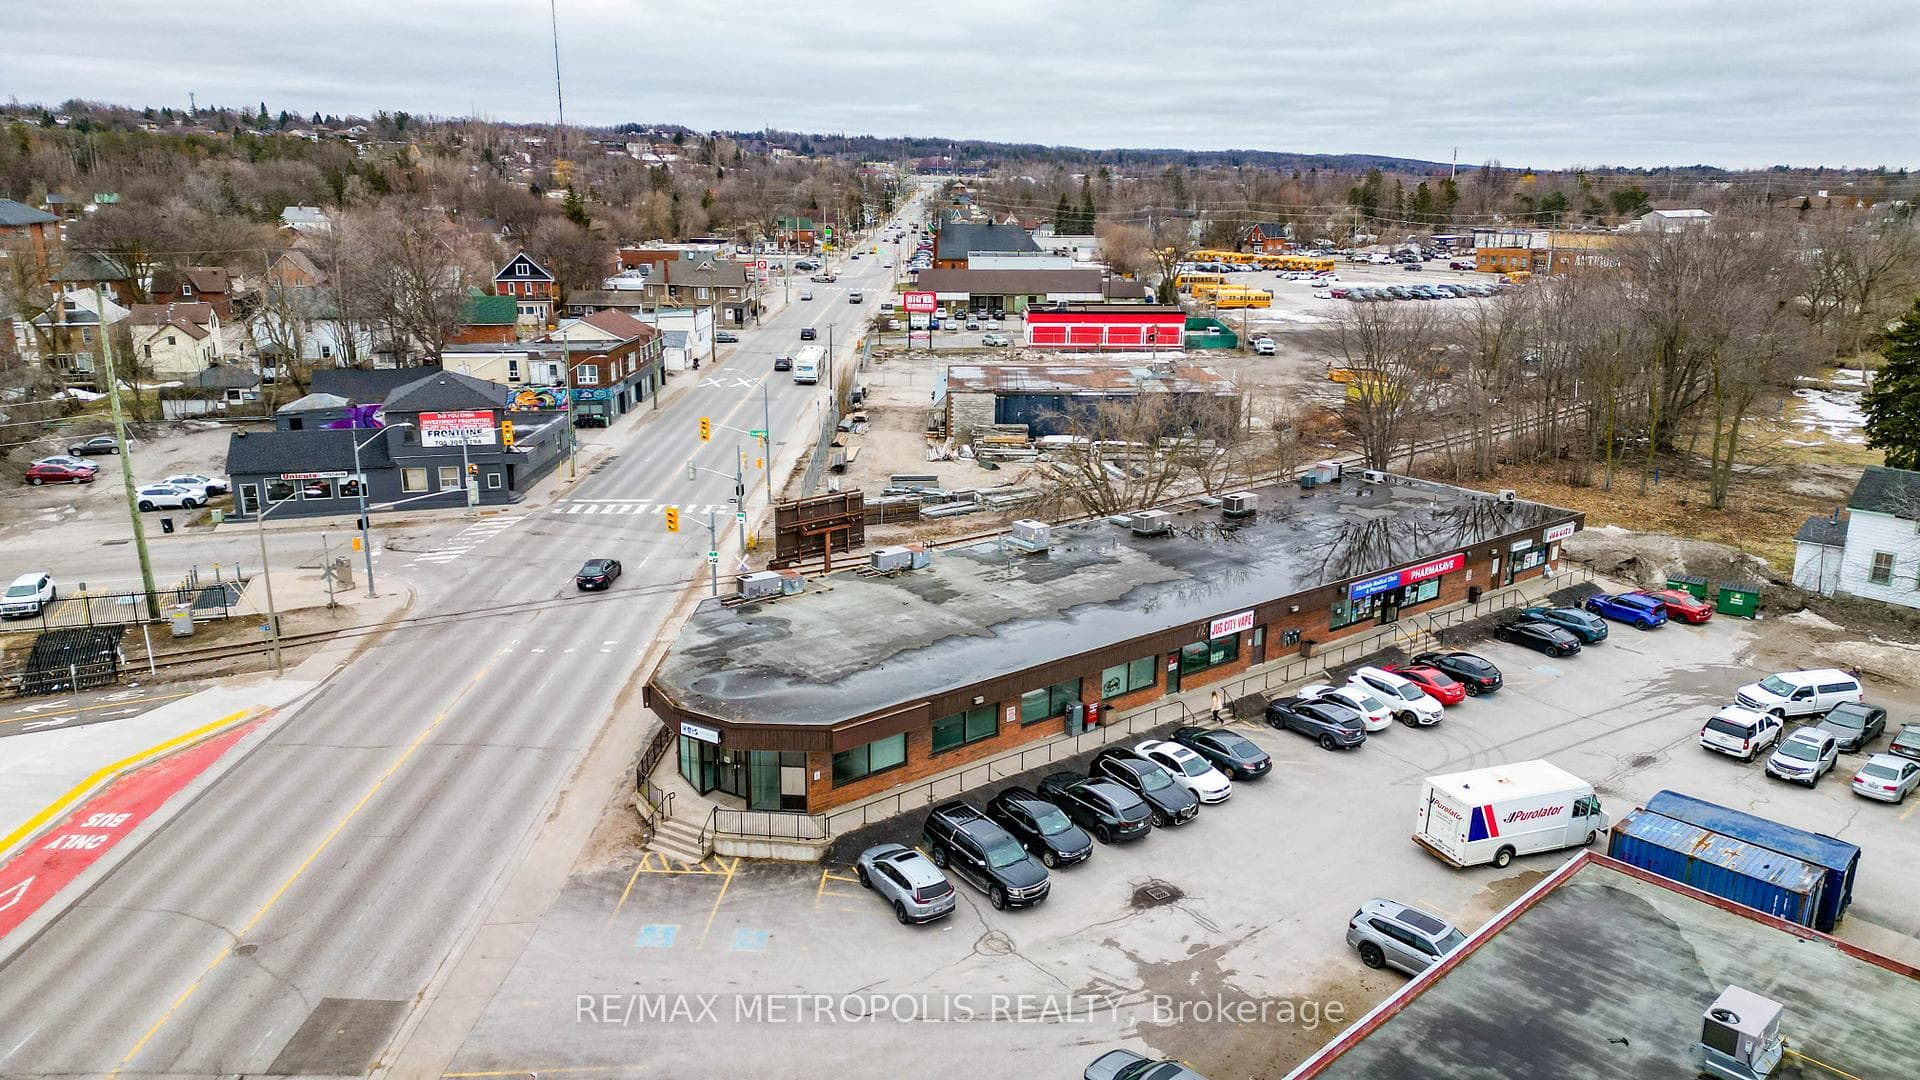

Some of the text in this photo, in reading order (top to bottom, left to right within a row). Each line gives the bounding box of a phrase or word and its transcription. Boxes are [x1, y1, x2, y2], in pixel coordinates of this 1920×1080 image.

[1410, 559, 1455, 581] PHARMASAVE
[1224, 617, 1237, 632] CITY
[1237, 614, 1252, 628] VAPE
[80, 812, 133, 828] BUS
[1513, 805, 1564, 823] Purolator
[42, 834, 109, 850] ONLY
